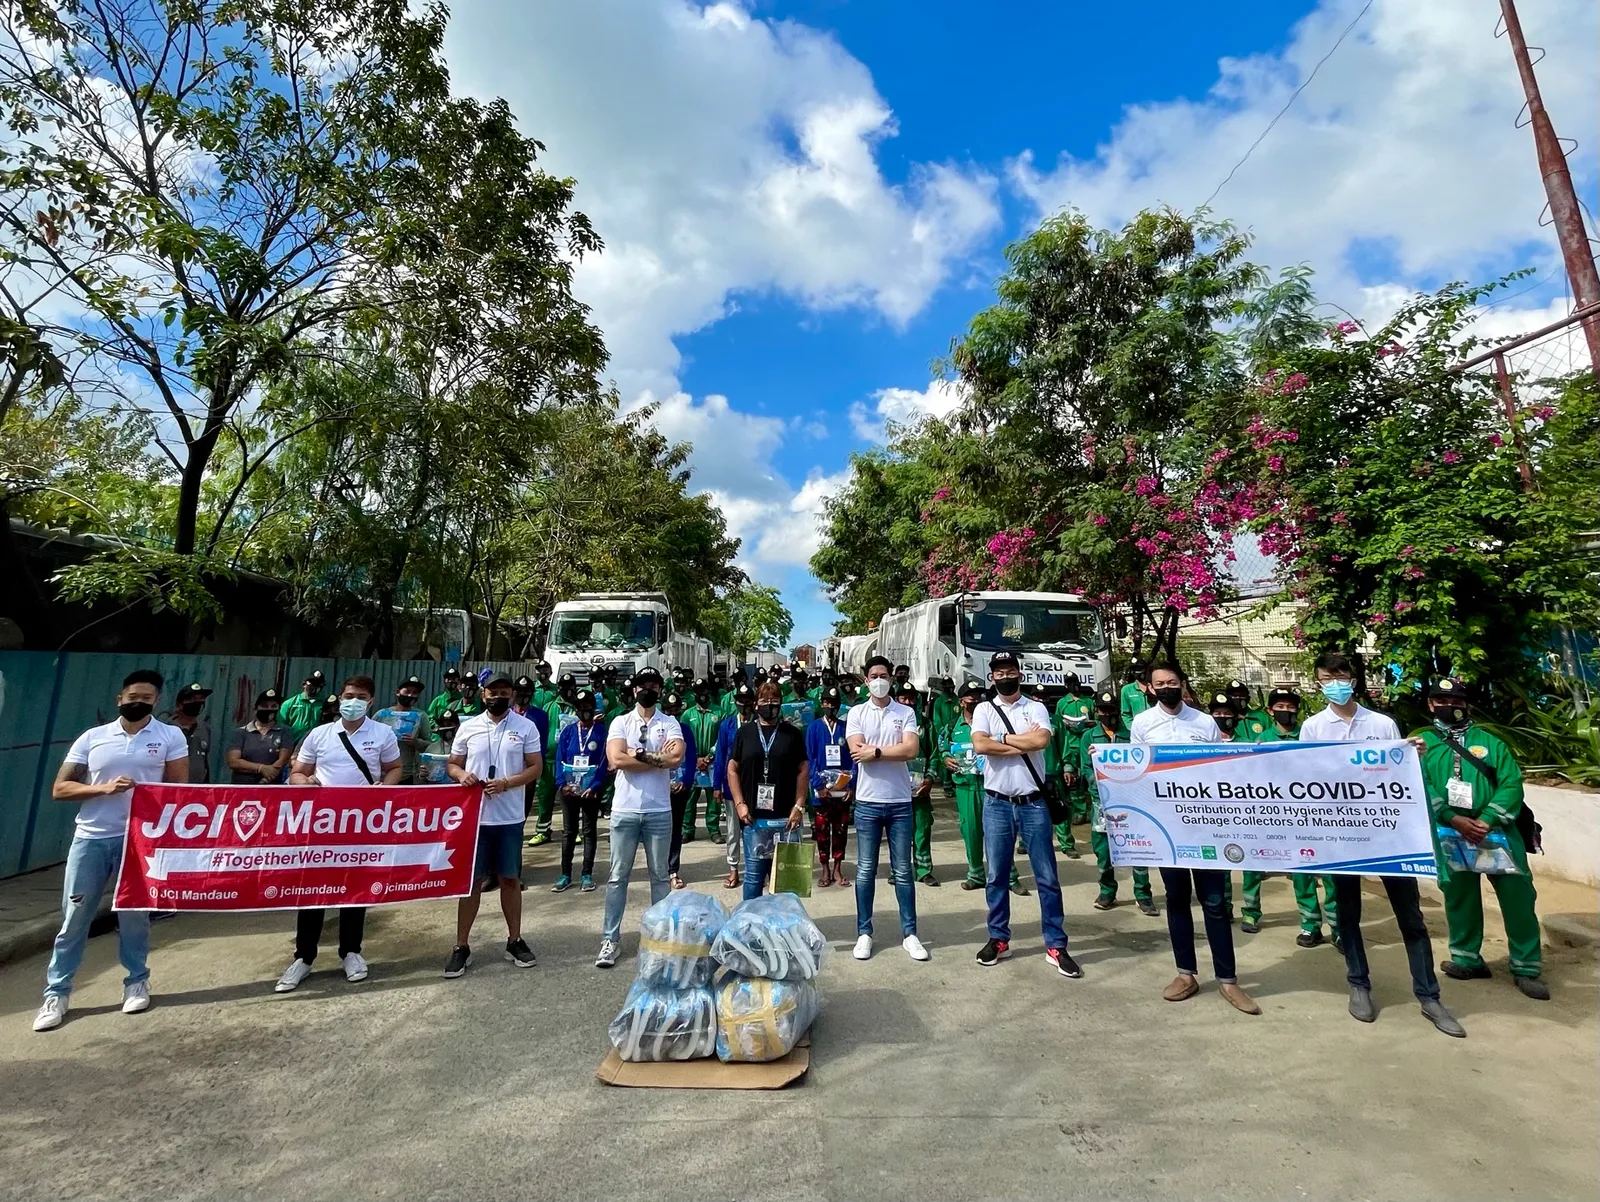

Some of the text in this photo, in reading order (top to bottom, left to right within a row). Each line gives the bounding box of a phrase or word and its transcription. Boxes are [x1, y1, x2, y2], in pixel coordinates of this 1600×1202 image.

[1036, 673, 1094, 684] MANUE
[1098, 749, 1128, 764] JCI
[1350, 750, 1386, 765] JCI
[1154, 782, 1412, 800] Lihok Batok COVID-19:
[275, 800, 464, 835] Mandaue
[1175, 804, 1400, 818] Distribution of 200 Hygiene Kits to the
[141, 802, 230, 840] JCI
[1182, 815, 1398, 830] Garbage Collectors of Mandaue City
[212, 850, 385, 870] #TogetherWeProsper
[1401, 862, 1412, 872] Be
[160, 889, 238, 901] JCI Mandaue
[280, 884, 347, 898] jcimandaue
[384, 880, 447, 895] jcimandaue
